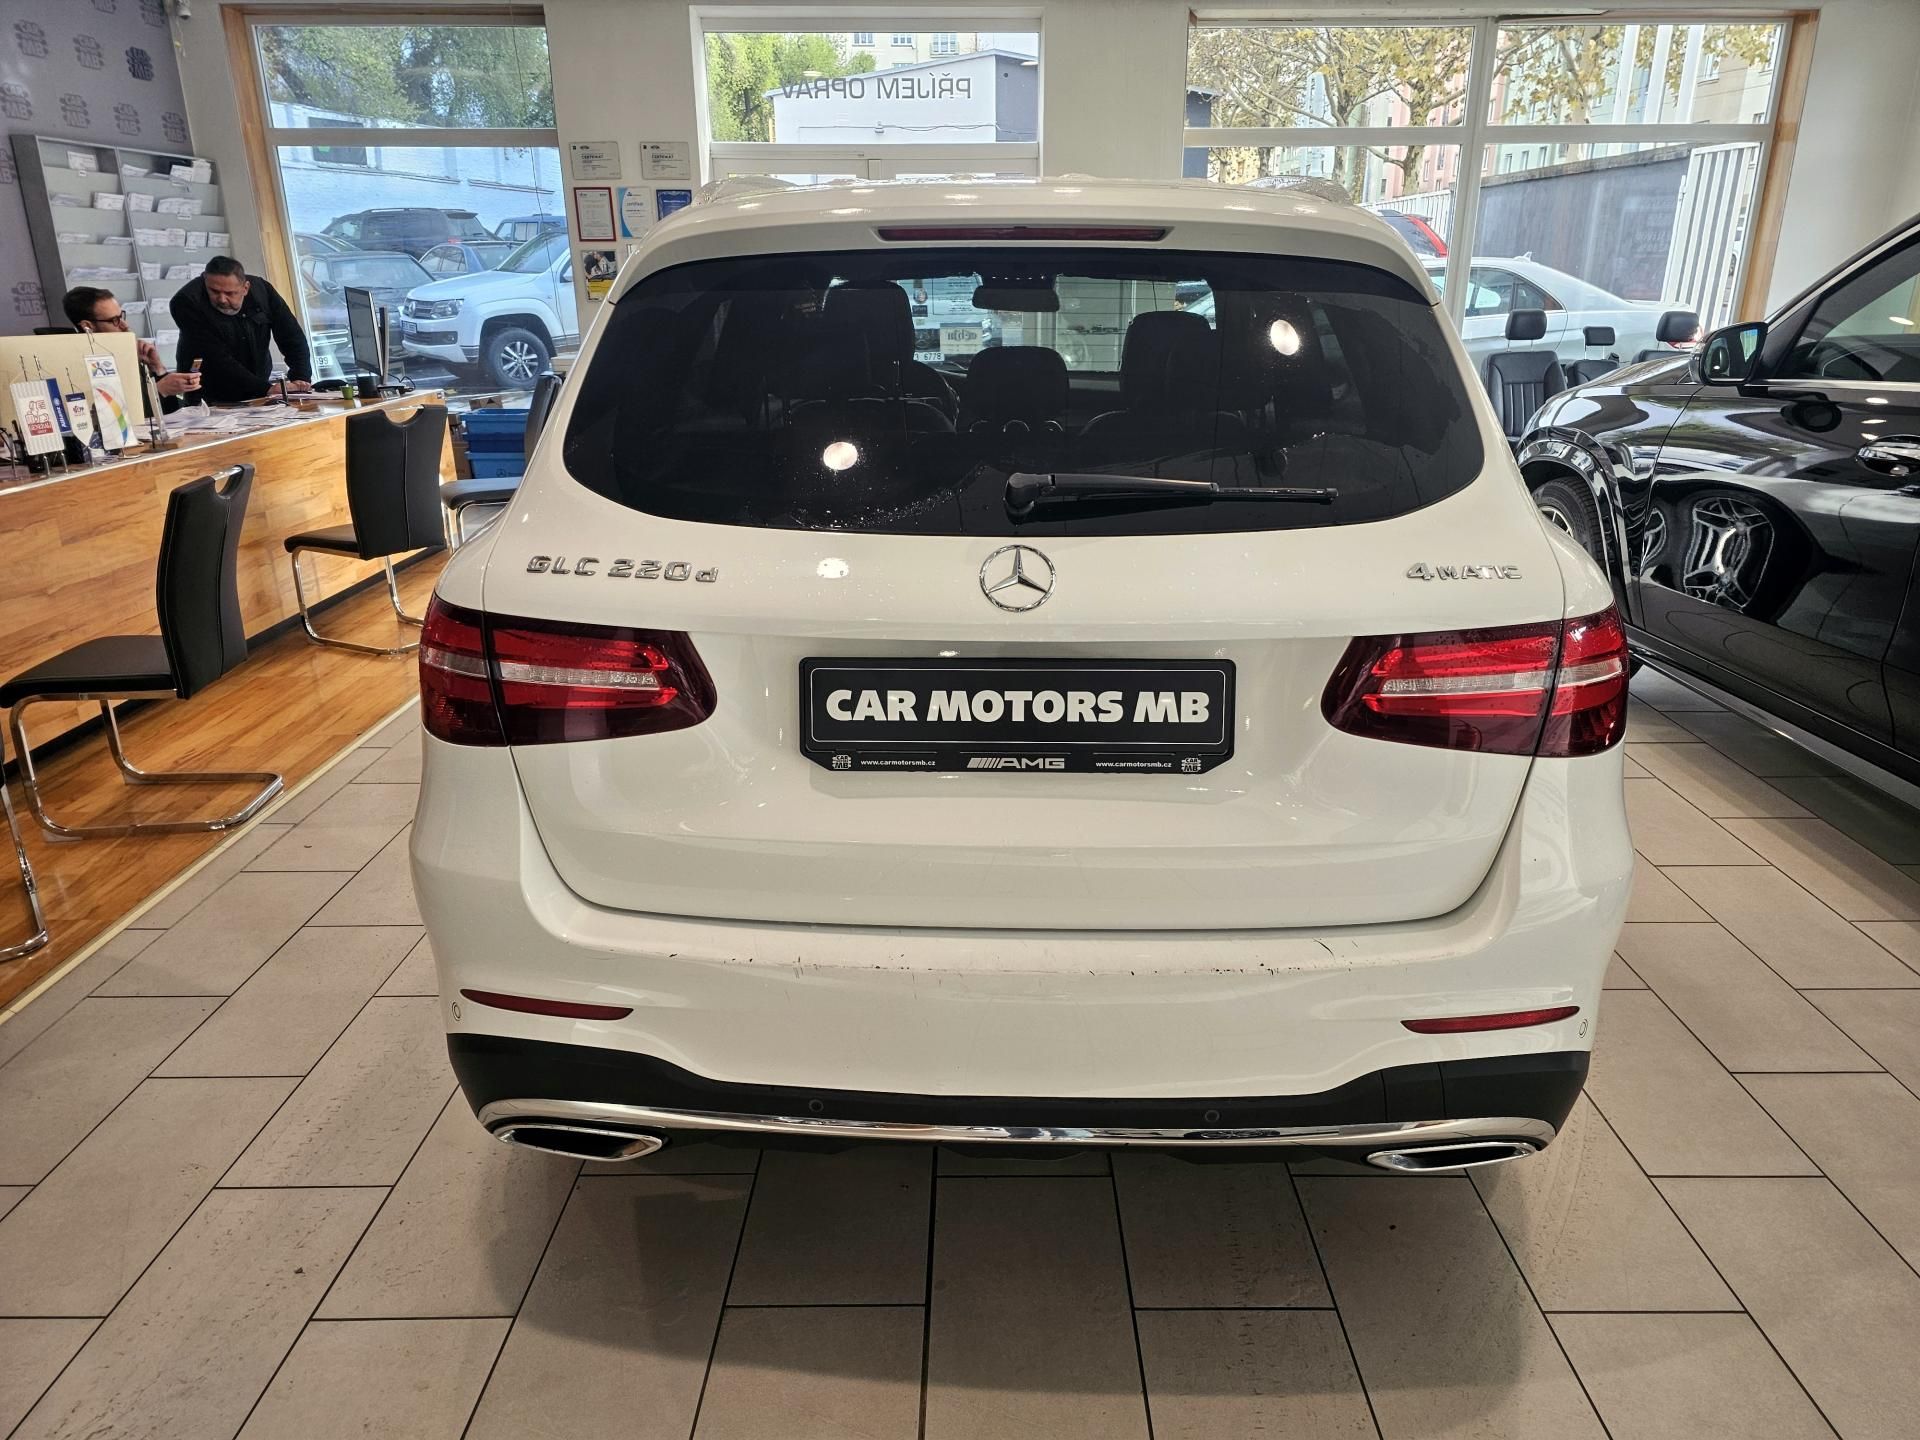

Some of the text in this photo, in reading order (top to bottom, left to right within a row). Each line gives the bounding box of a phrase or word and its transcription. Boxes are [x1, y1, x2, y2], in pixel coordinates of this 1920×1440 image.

[19, 301, 42, 315] MB
[526, 555, 600, 576] GLC
[1406, 562, 1522, 580] 4MATIC
[826, 689, 1210, 723] CAR MOTORS MB
[860, 759, 936, 767] www.carmotorsmb.cz
[996, 757, 1066, 769] AMG
[1095, 760, 1172, 768] www.carmotorsmb.cz
